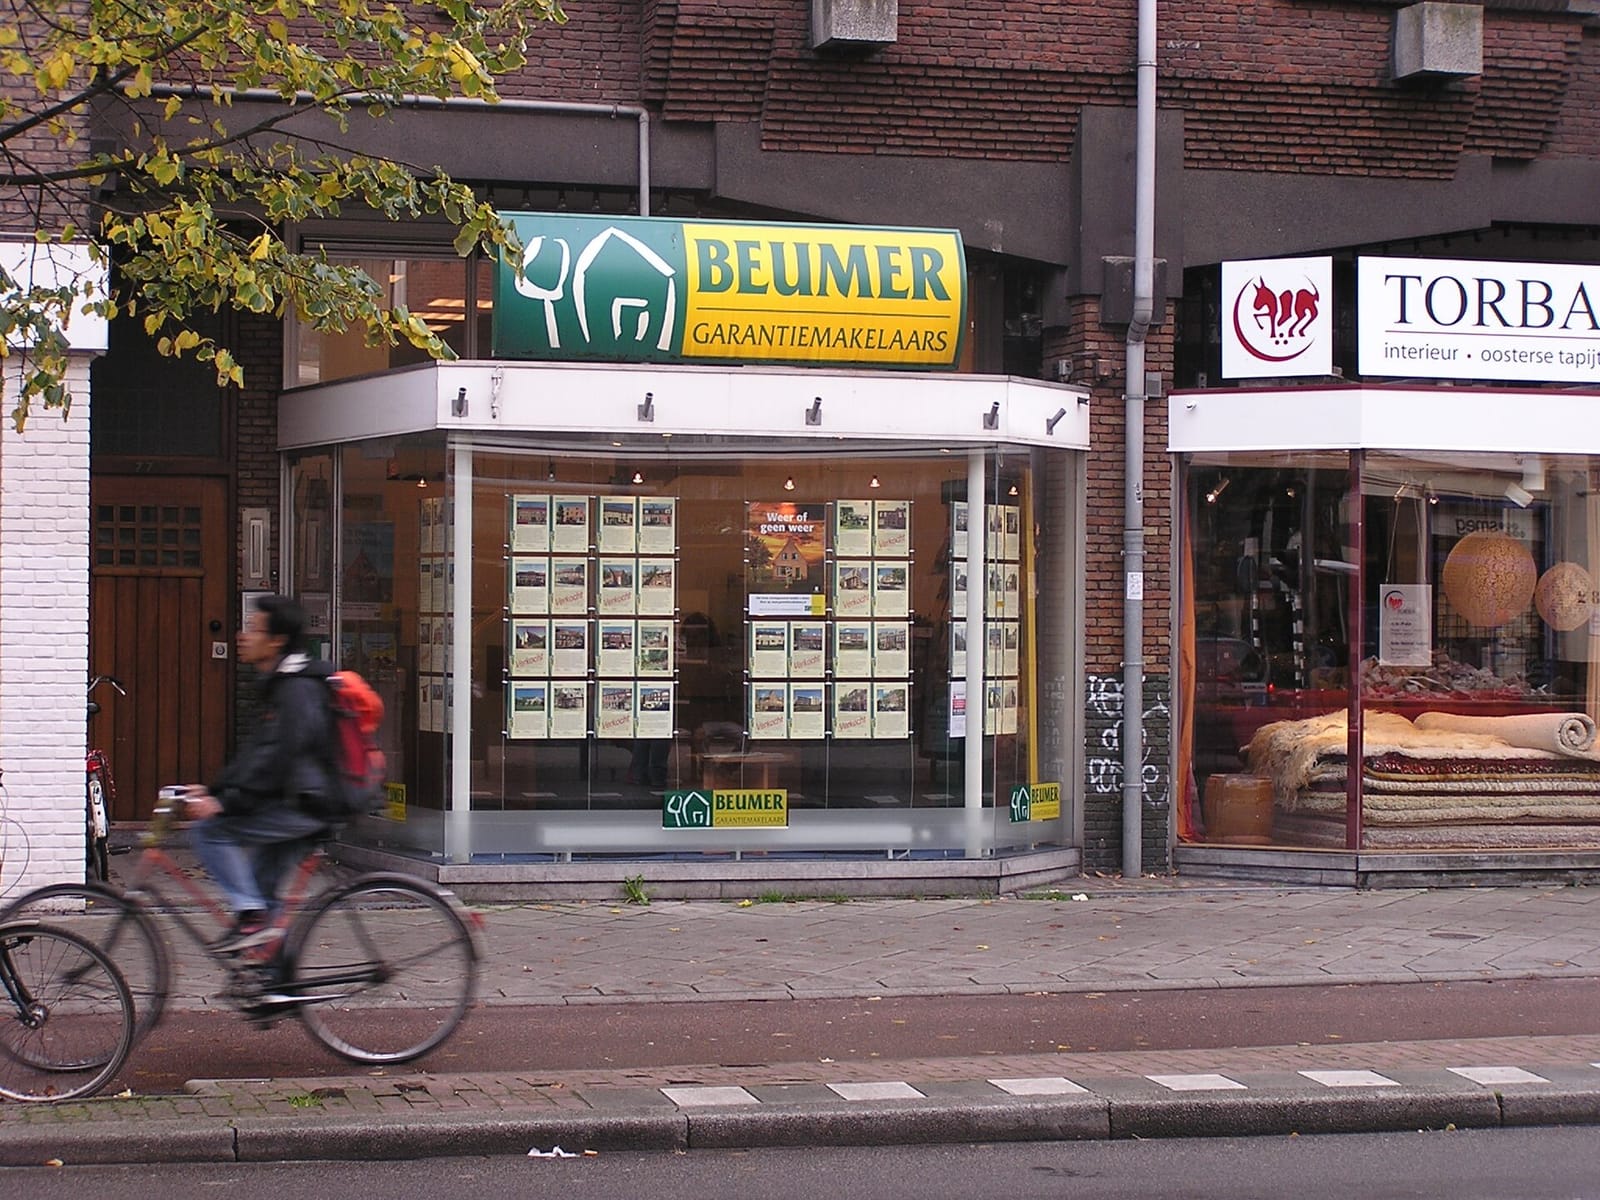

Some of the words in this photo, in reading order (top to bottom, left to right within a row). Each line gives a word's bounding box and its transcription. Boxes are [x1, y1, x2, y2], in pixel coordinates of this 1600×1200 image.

[694, 238, 952, 301] BEUMER
[1384, 274, 1600, 330] TORBA
[693, 322, 948, 352] GARANTIEMAKELAARS
[1384, 342, 1459, 360] interieur
[1480, 348, 1554, 363] oosterse
[767, 512, 794, 522] Weer
[796, 512, 808, 522] of
[760, 524, 785, 535] geen
[788, 524, 814, 533] weer
[715, 794, 784, 810] BEUMER
